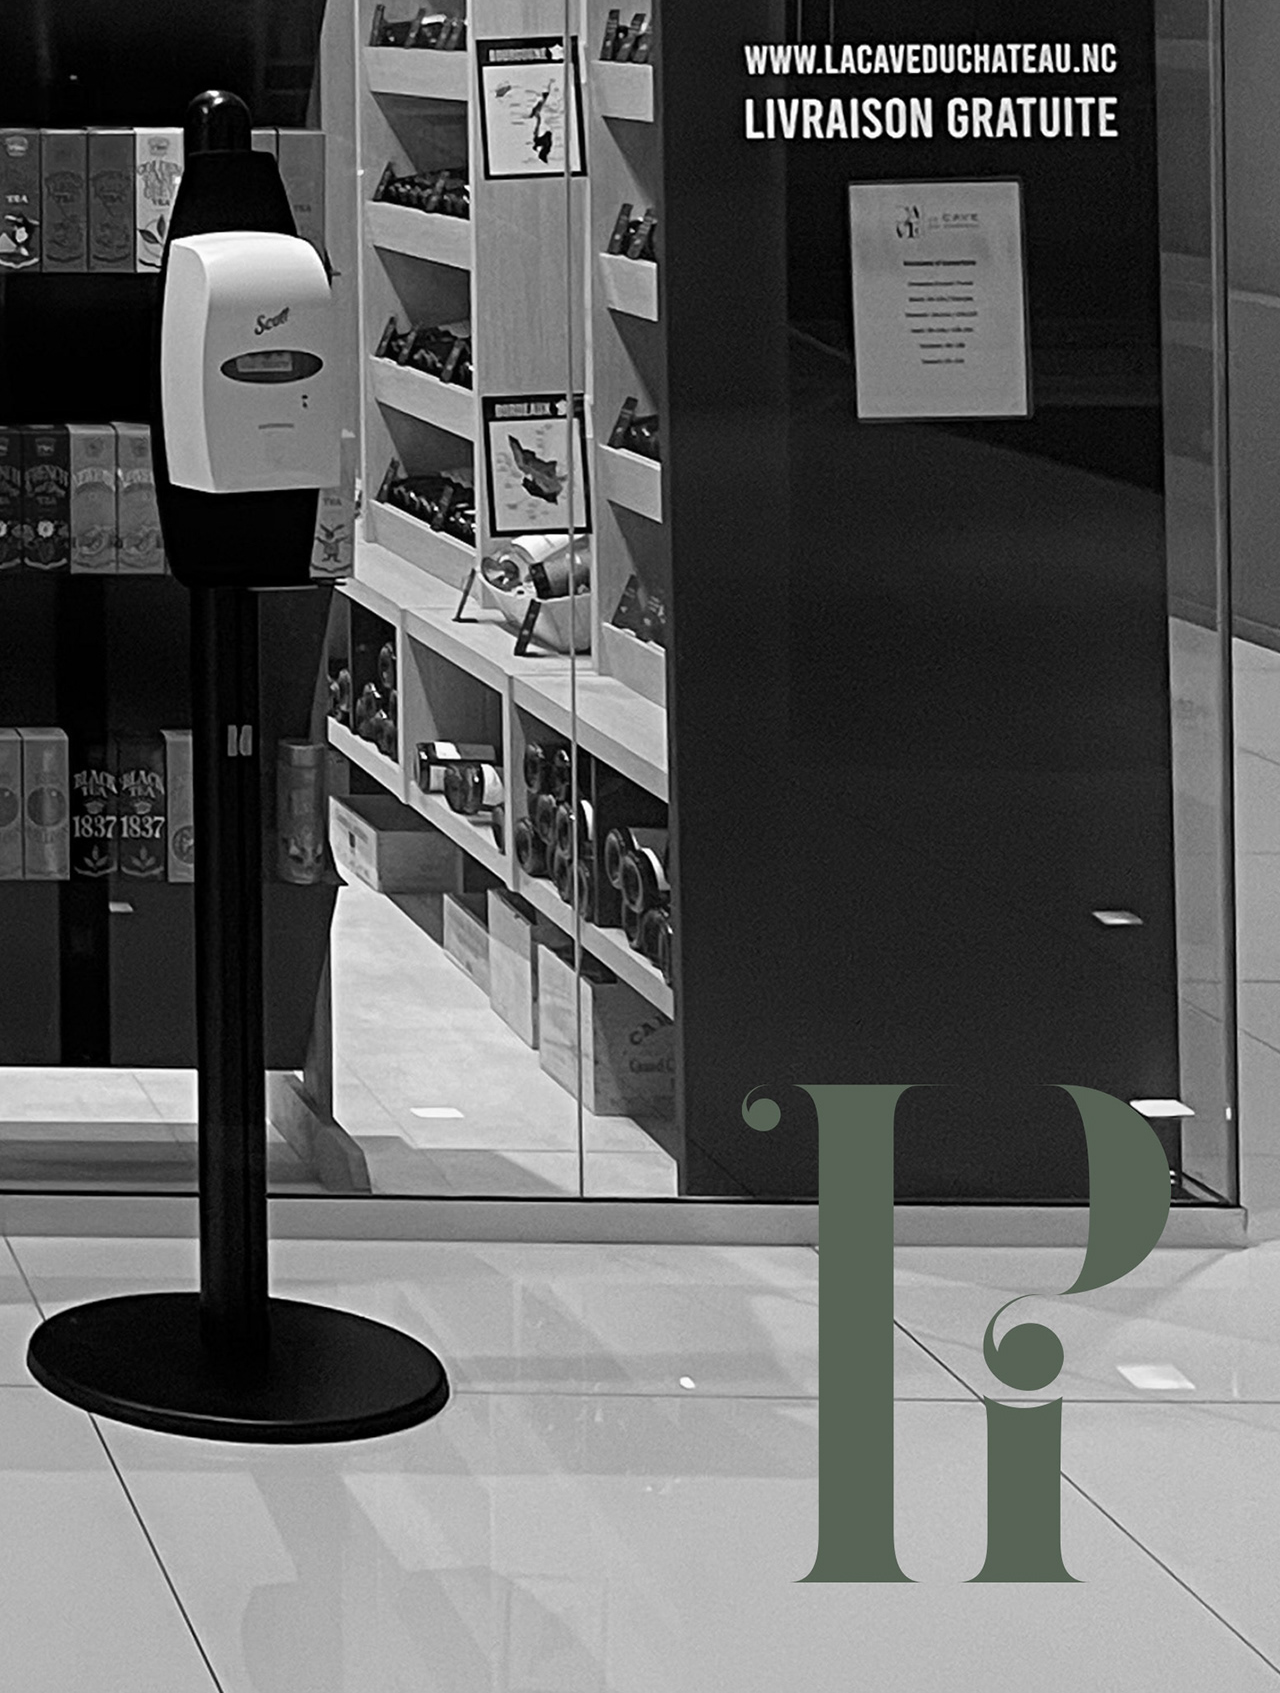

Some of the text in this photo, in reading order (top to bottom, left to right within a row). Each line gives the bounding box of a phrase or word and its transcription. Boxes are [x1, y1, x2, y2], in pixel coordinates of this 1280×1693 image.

[744, 43, 1117, 75] WWW.LACAVEDUCHATEAU.NC
[745, 96, 1119, 139] LIVRAISON GRATUITE
[73, 769, 118, 795] BLACK
[121, 769, 165, 795] BLACK
[72, 815, 118, 839] 1837
[120, 815, 166, 839] 1837
